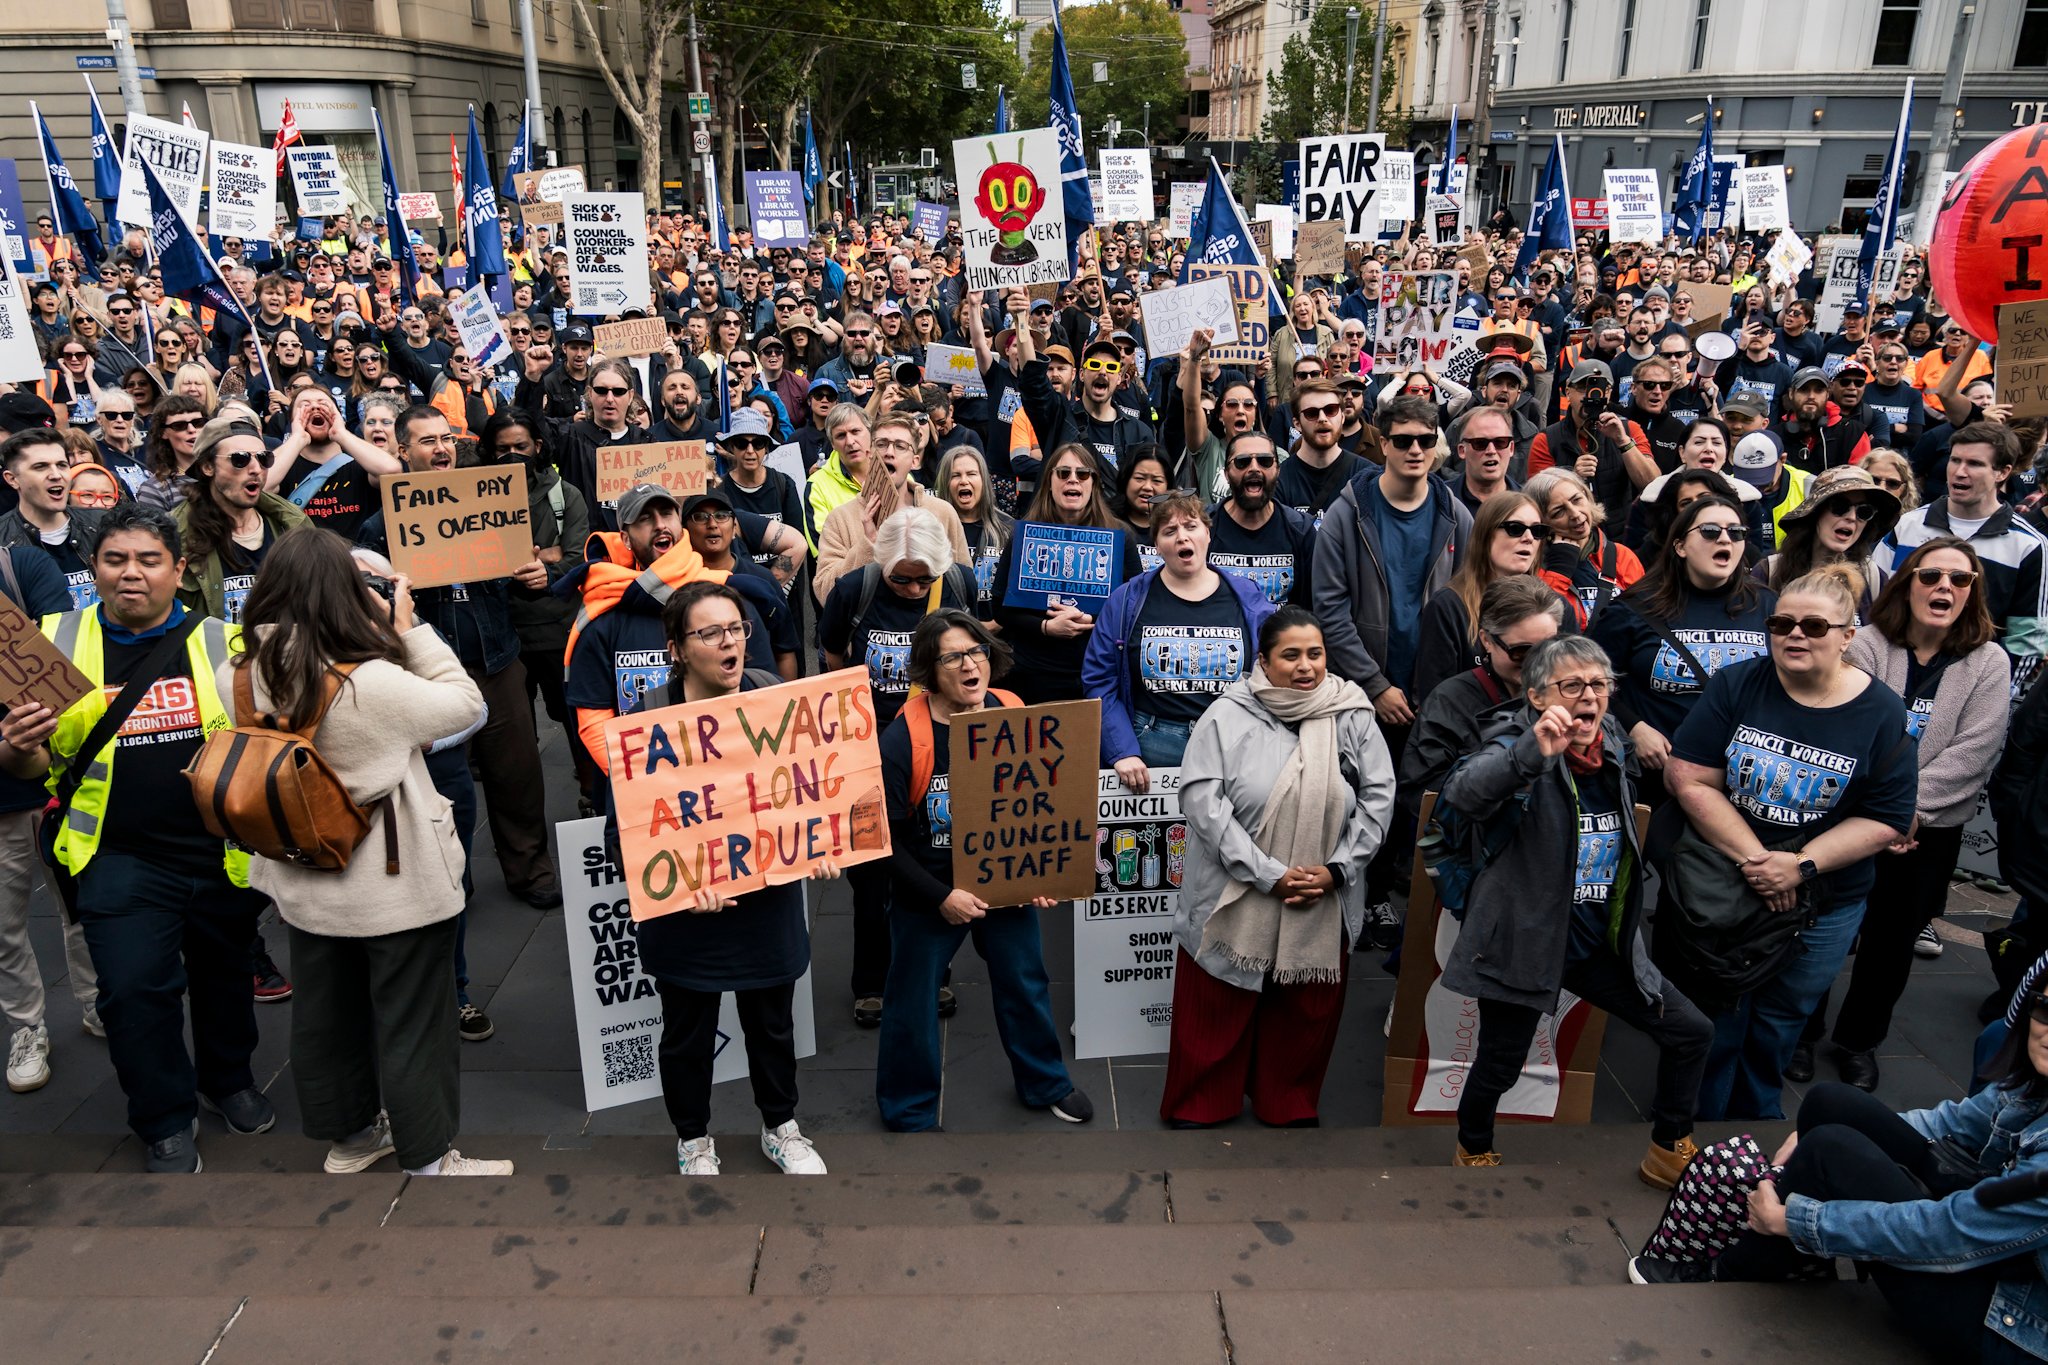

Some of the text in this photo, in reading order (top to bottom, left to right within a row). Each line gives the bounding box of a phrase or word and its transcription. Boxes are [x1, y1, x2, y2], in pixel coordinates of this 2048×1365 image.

[83, 58, 104, 66] Spring
[317, 102, 358, 110] WINDSOR
[1583, 104, 1639, 127] IMPERIAL
[133, 124, 202, 147] COUNCIL WORKERS
[696, 137, 708, 146] 40
[1491, 132, 1507, 140] Spring
[217, 150, 254, 162] SICK OF
[217, 157, 239, 167] THIS
[291, 152, 335, 162] VICTORIA.
[307, 161, 322, 170] THE
[1305, 141, 1380, 188] FAIR
[164, 169, 197, 183] FAIR PAY
[217, 169, 260, 181] COUNCIL
[217, 176, 267, 189] WORKERS
[756, 179, 791, 187] LIBRARY
[1608, 175, 1654, 184] VICTORIA.
[217, 183, 259, 195] ARE SICK
[307, 180, 330, 189] STATE
[1625, 184, 1640, 192] THE
[217, 196, 255, 207] WAGES.
[536, 204, 558, 212] COUNCIL
[571, 204, 616, 213] SICK OF
[759, 202, 795, 210] LIBRARY
[1622, 202, 1647, 211] STATE
[571, 213, 621, 222] THIS ?
[758, 209, 799, 218] WORKERS
[920, 207, 942, 216] LIBRARY
[1305, 189, 1376, 234] PAY
[573, 228, 627, 238] COUNCIL
[965, 222, 1063, 248] THE VERY
[574, 237, 635, 247] WORKERS
[575, 246, 627, 256] ARE SICK
[576, 255, 592, 264] OF
[576, 264, 624, 273] WAGES.
[968, 258, 1069, 290] HUNGRY LIBRARIAN
[203, 284, 239, 314] your side
[1381, 273, 1454, 309] FAIR
[1150, 286, 1195, 315] ACT
[1148, 312, 1194, 336] YOUR
[1384, 303, 1449, 337] PAY
[2014, 309, 2036, 324] WE
[595, 318, 666, 342] I'M STRIKING
[614, 340, 626, 350] the
[1153, 334, 1190, 354] WAG
[1374, 335, 1449, 367] NOW
[2011, 346, 2036, 360] THE
[951, 357, 973, 367] STRIKE
[2010, 364, 2046, 384] BUT
[2004, 386, 2029, 404] NOT
[600, 445, 702, 471] FAIR FAIR
[633, 460, 668, 480] deserves
[660, 469, 705, 491] PAY!
[391, 473, 514, 514] FAIR PAY
[334, 503, 361, 515] Lives
[399, 508, 529, 548] IS OVERDUE
[1025, 525, 1112, 545] COUNCIL WORKERS
[1210, 553, 1293, 567] COUNCIL WORKERS
[1021, 578, 1109, 596] DESERVE FAIR PAY
[869, 632, 912, 646] COUNCIL
[1143, 627, 1241, 640] COUNCIL WORKERS
[1714, 632, 1764, 646] WORKERS
[617, 652, 666, 667] COUNCIL
[1145, 679, 1220, 692] DESERVE FAIR
[125, 711, 198, 732] FRONTLINE
[123, 727, 205, 747] LOCAL SERVICES
[619, 683, 873, 780] FAIR WAGES
[968, 715, 1064, 761] FAIR
[1735, 725, 1855, 774] COUNCIL WORKERS
[992, 754, 1065, 793] PAY
[649, 752, 846, 838] ARE LONG
[990, 791, 1055, 823] FOR
[1099, 797, 1169, 818] OUNCIL
[1767, 806, 1799, 826] FAIR
[963, 819, 1091, 856] COUNCIL
[641, 813, 844, 901] OVERDUE!
[977, 847, 1073, 885] STAFF
[1089, 895, 1169, 918] DESERVE
[1129, 931, 1173, 947] SHOW
[1133, 948, 1173, 964] YOUR
[594, 961, 636, 987] OF
[1104, 965, 1174, 983] SUPPORT
[600, 1015, 663, 1037] SHOW YOU
